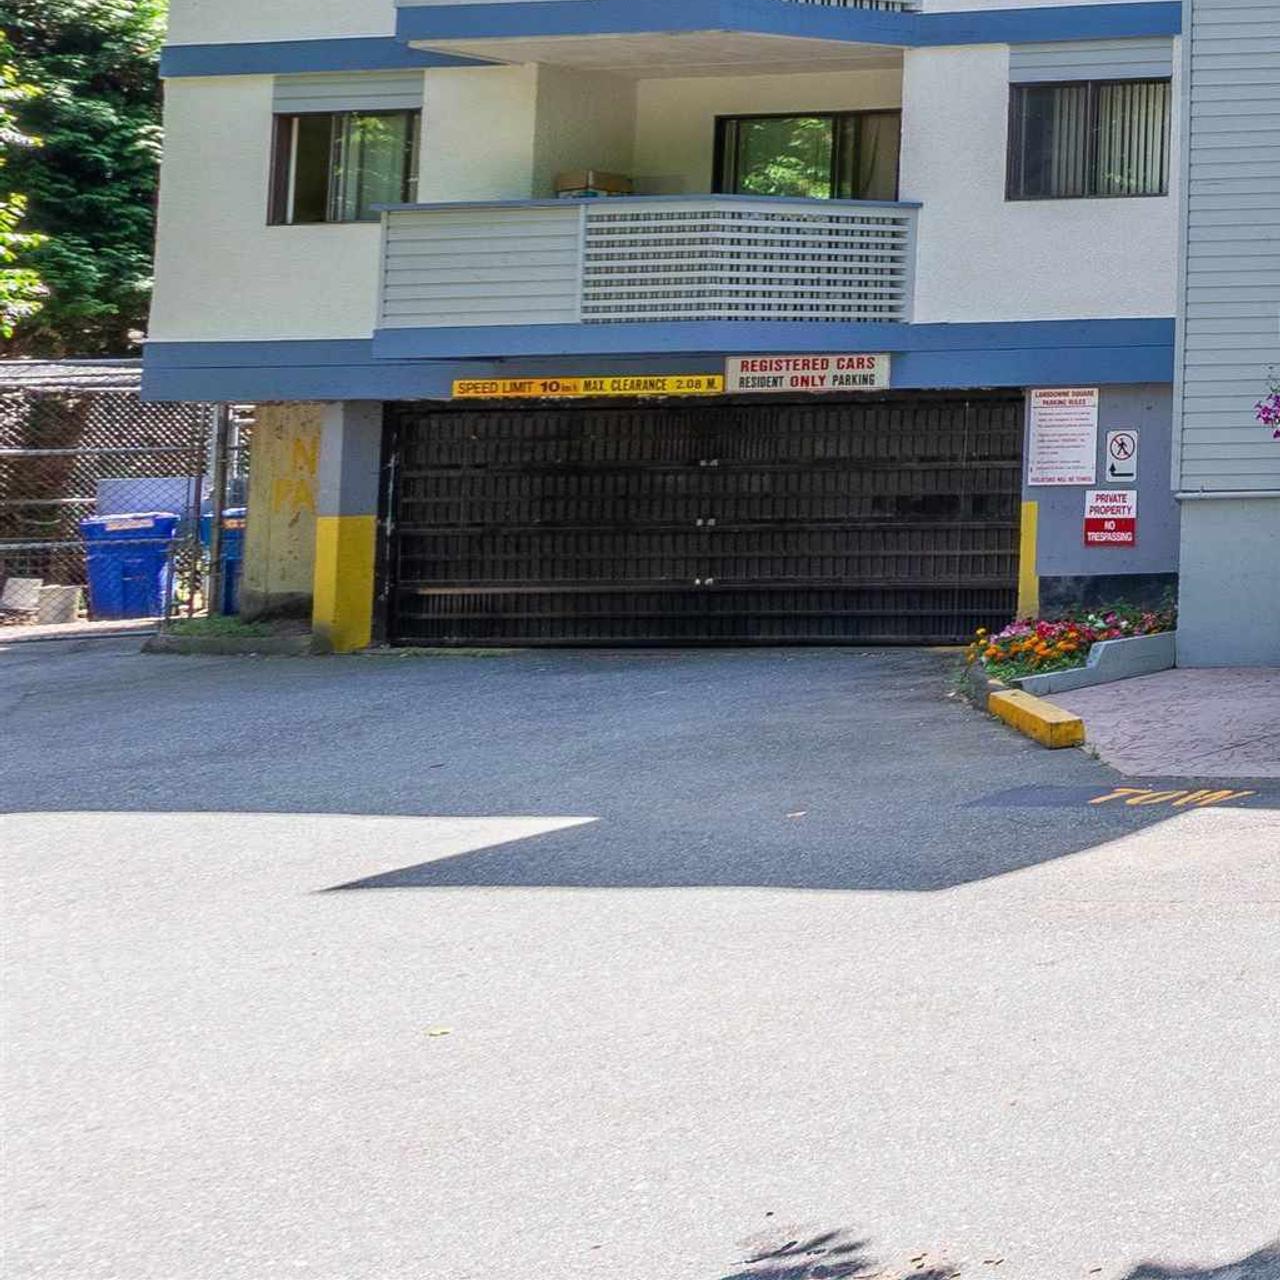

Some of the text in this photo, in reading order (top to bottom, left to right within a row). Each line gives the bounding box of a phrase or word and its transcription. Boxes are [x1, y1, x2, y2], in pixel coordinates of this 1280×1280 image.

[740, 356, 876, 373] REGISTERED CARS
[458, 381, 498, 394] SPEED
[502, 381, 534, 394] LIMIT
[539, 380, 560, 393] 10
[611, 378, 667, 391] CLEARANCE
[739, 374, 875, 389] RESIDENT ONLY PARKING
[1095, 493, 1128, 503] PRIVATE
[1089, 505, 1132, 515] PROPERTY
[1103, 520, 1116, 530] NO
[1087, 532, 1133, 542] TRESPASSING
[1089, 787, 1256, 807] TOW
